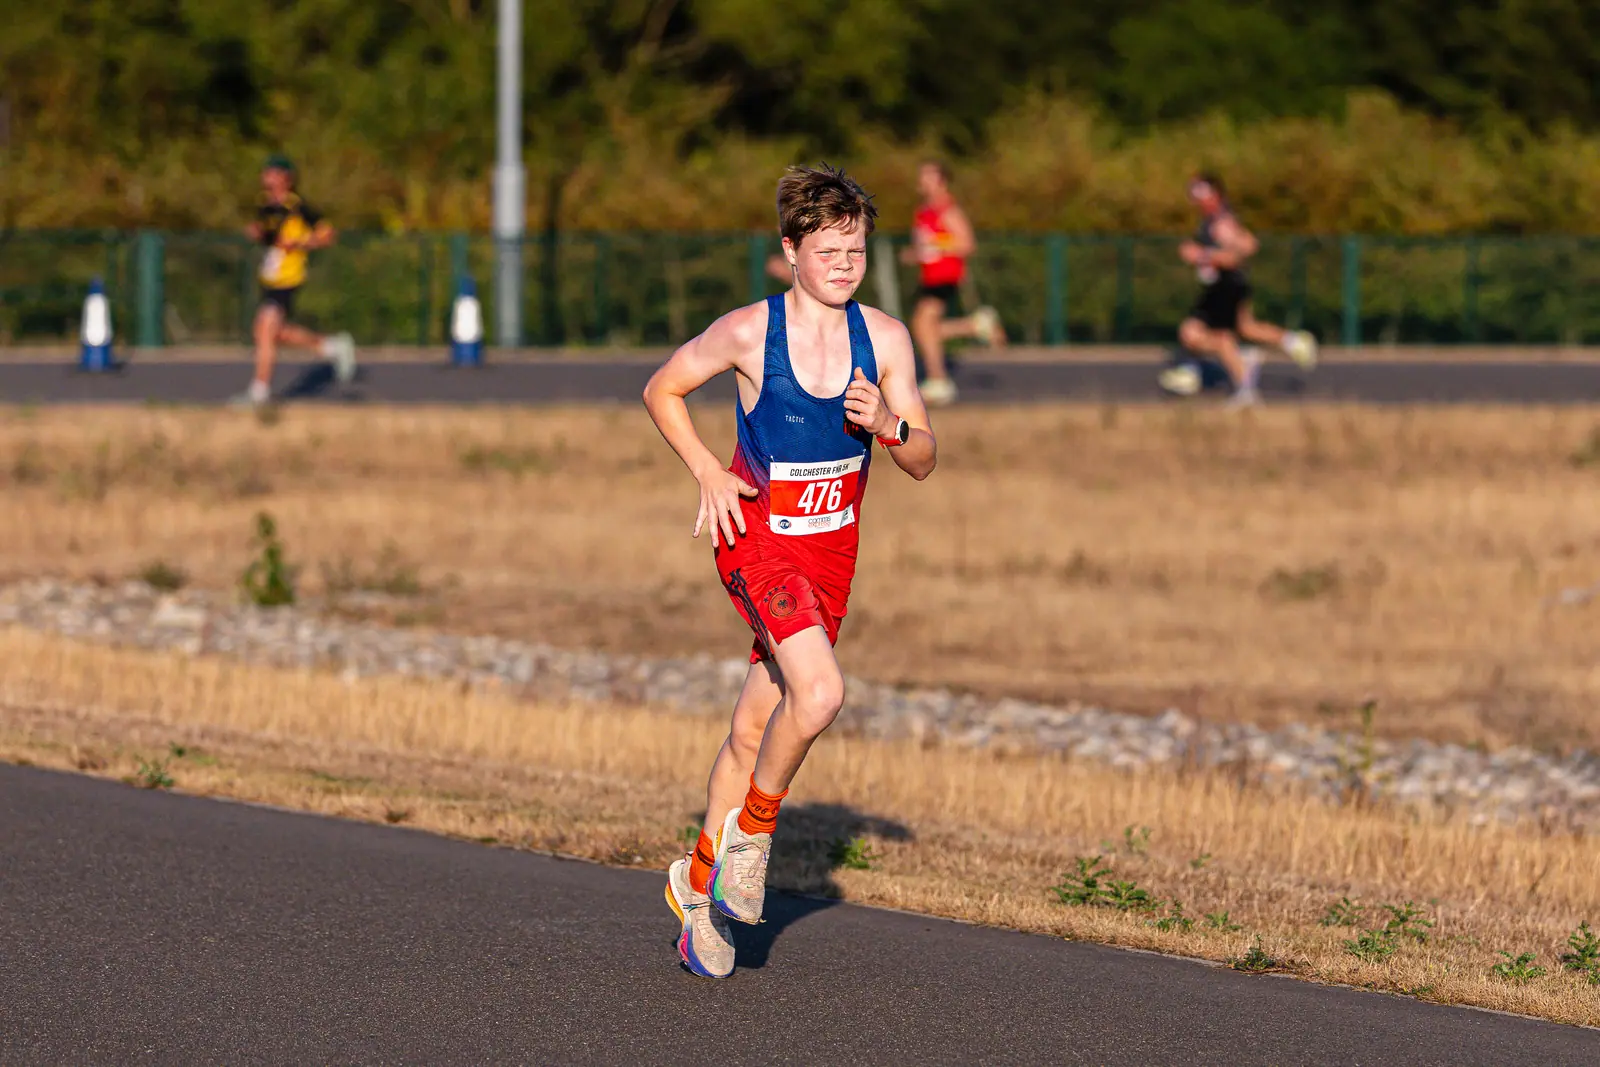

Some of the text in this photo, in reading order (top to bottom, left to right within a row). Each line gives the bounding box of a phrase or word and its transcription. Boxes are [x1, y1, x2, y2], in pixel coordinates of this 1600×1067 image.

[785, 415, 805, 424] TACTIC
[790, 467, 831, 477] COLCHESTER
[842, 463, 850, 472] 5K
[797, 479, 843, 514] 476
